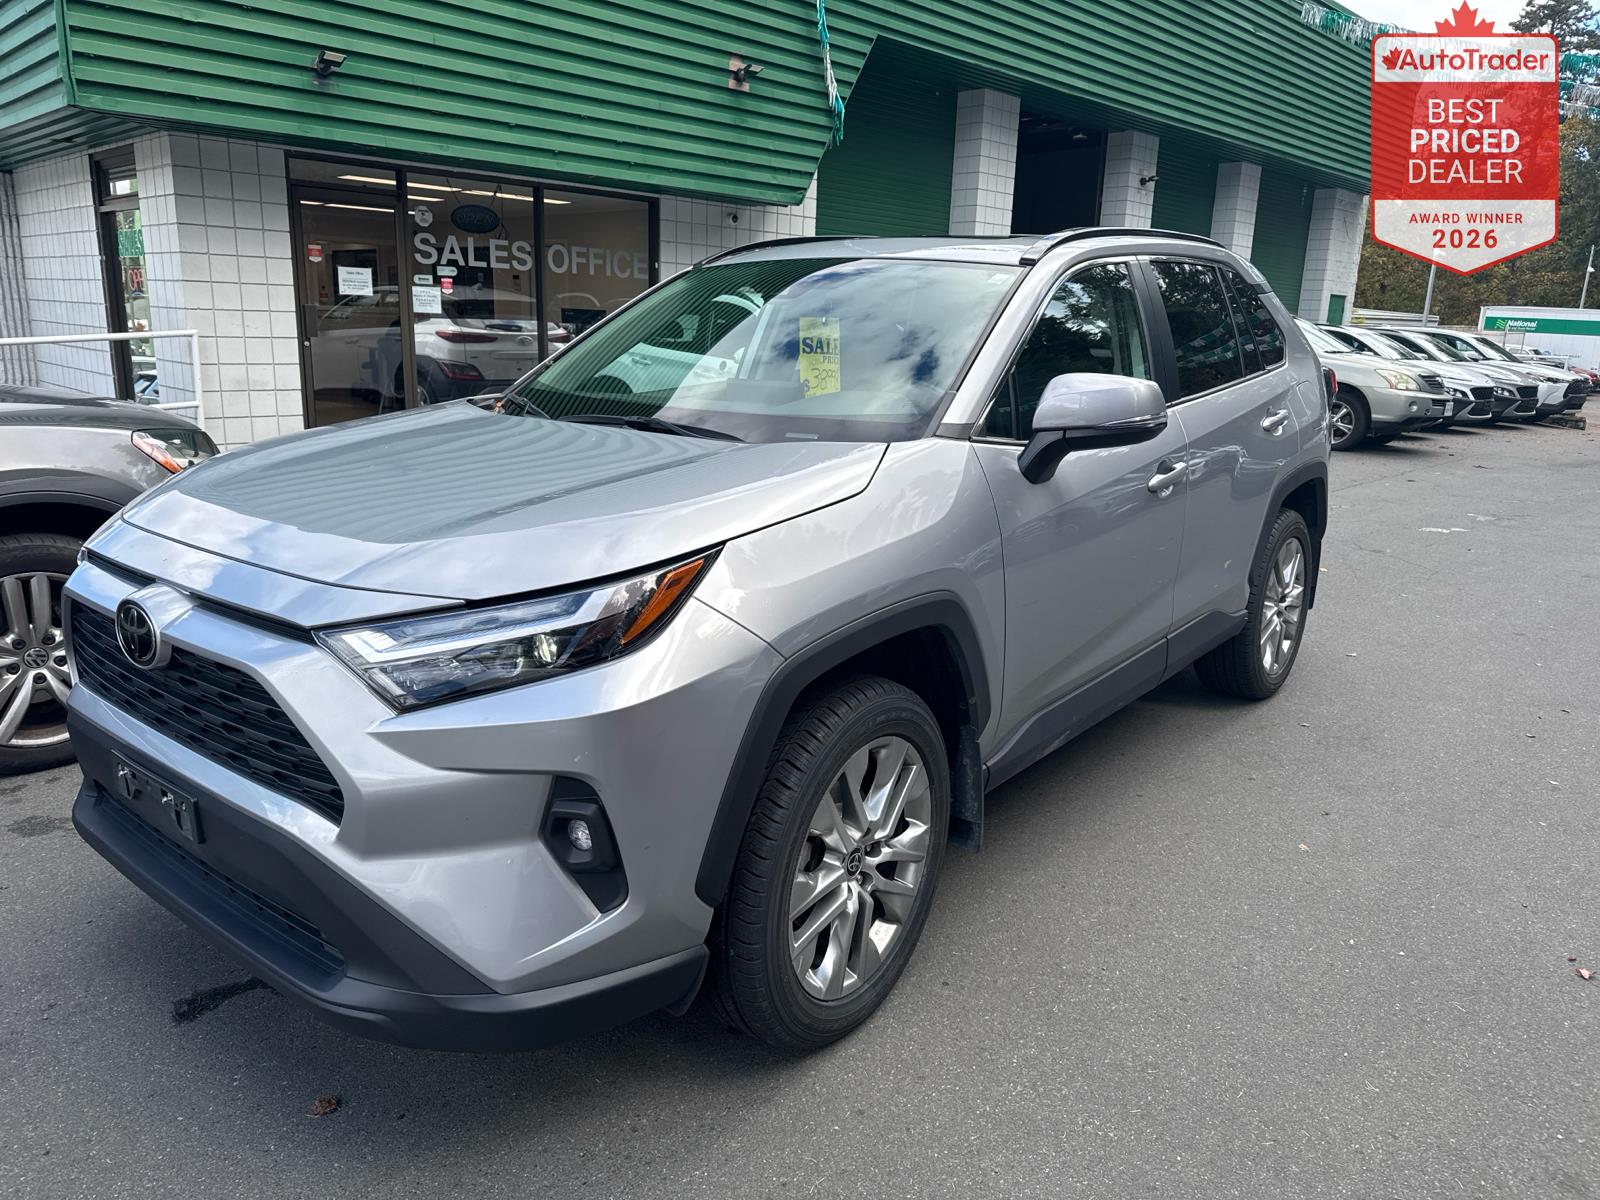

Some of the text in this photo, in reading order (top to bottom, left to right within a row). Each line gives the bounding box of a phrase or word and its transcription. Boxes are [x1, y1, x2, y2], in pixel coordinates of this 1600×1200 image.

[413, 232, 649, 280] SALES OFFICE
[128, 268, 144, 291] OPE
[1507, 319, 1538, 328] National
[801, 336, 839, 356] SALE
[822, 355, 839, 364] PRIC
